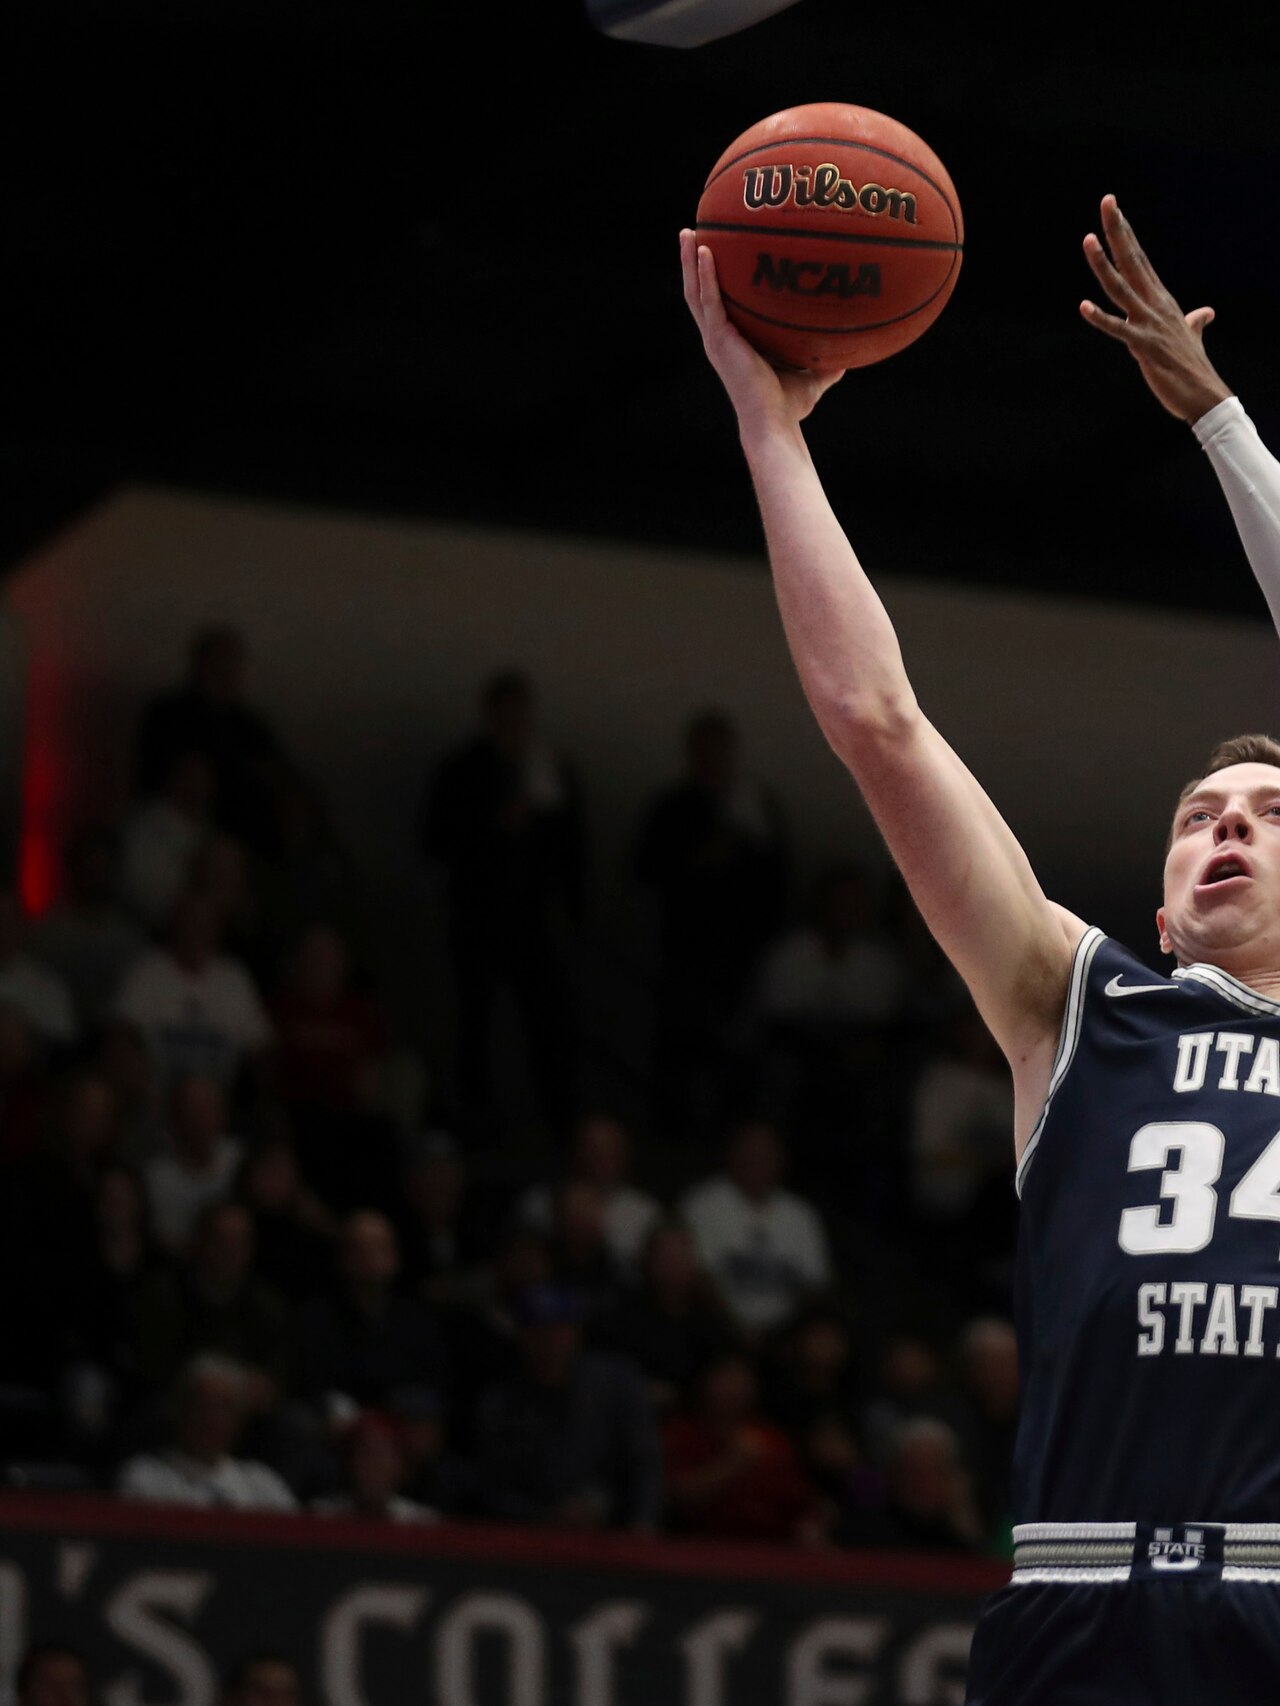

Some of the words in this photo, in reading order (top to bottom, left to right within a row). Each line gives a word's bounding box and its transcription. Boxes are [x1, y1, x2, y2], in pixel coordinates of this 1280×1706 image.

[743, 163, 919, 225] Wilson
[753, 253, 881, 299] NCAA
[1148, 1541, 1207, 1559] STATE
[0, 1542, 221, 1706] 'S
